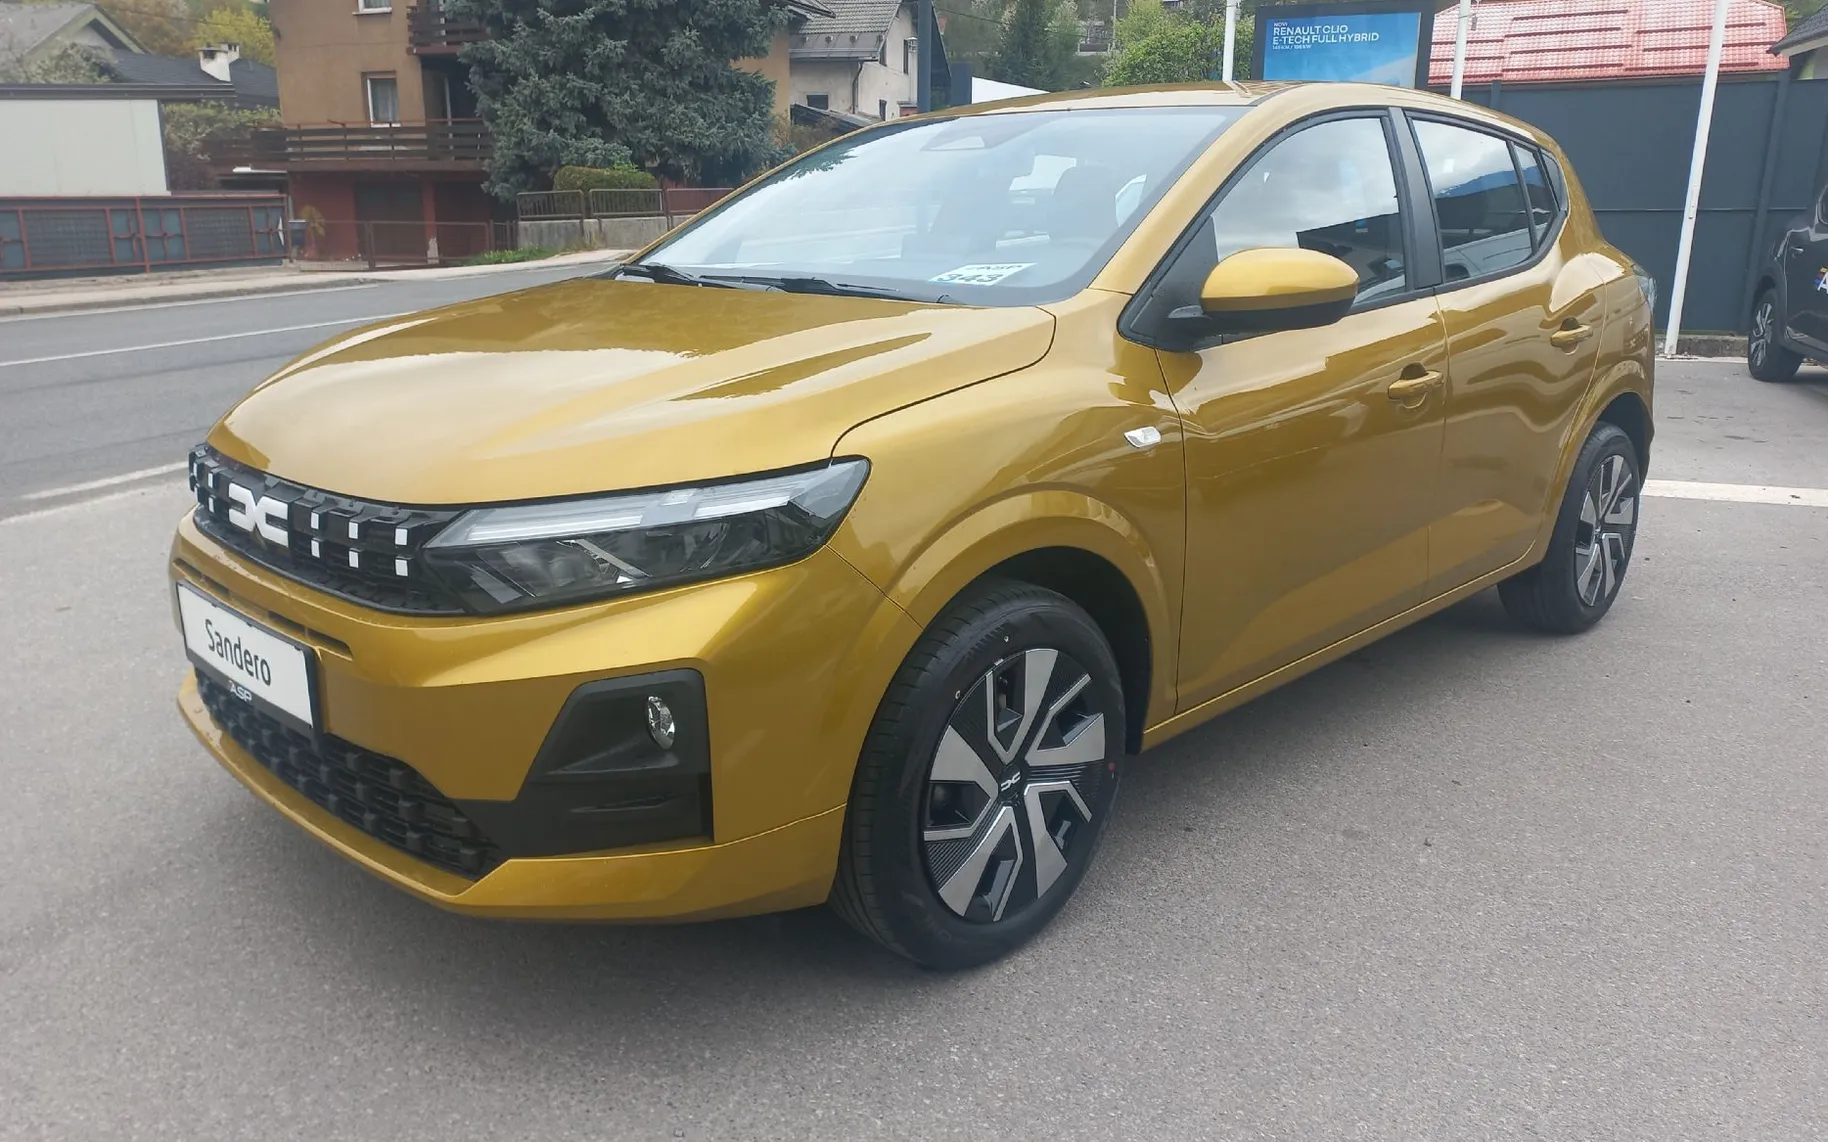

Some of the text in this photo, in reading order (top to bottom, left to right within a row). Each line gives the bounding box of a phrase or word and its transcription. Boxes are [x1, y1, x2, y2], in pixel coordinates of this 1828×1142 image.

[1273, 25, 1348, 36] RENAULT CLIO
[1272, 33, 1379, 45] E-TECH FULL HYBRID
[937, 273, 1004, 283] 343
[205, 618, 272, 687] Sandero
